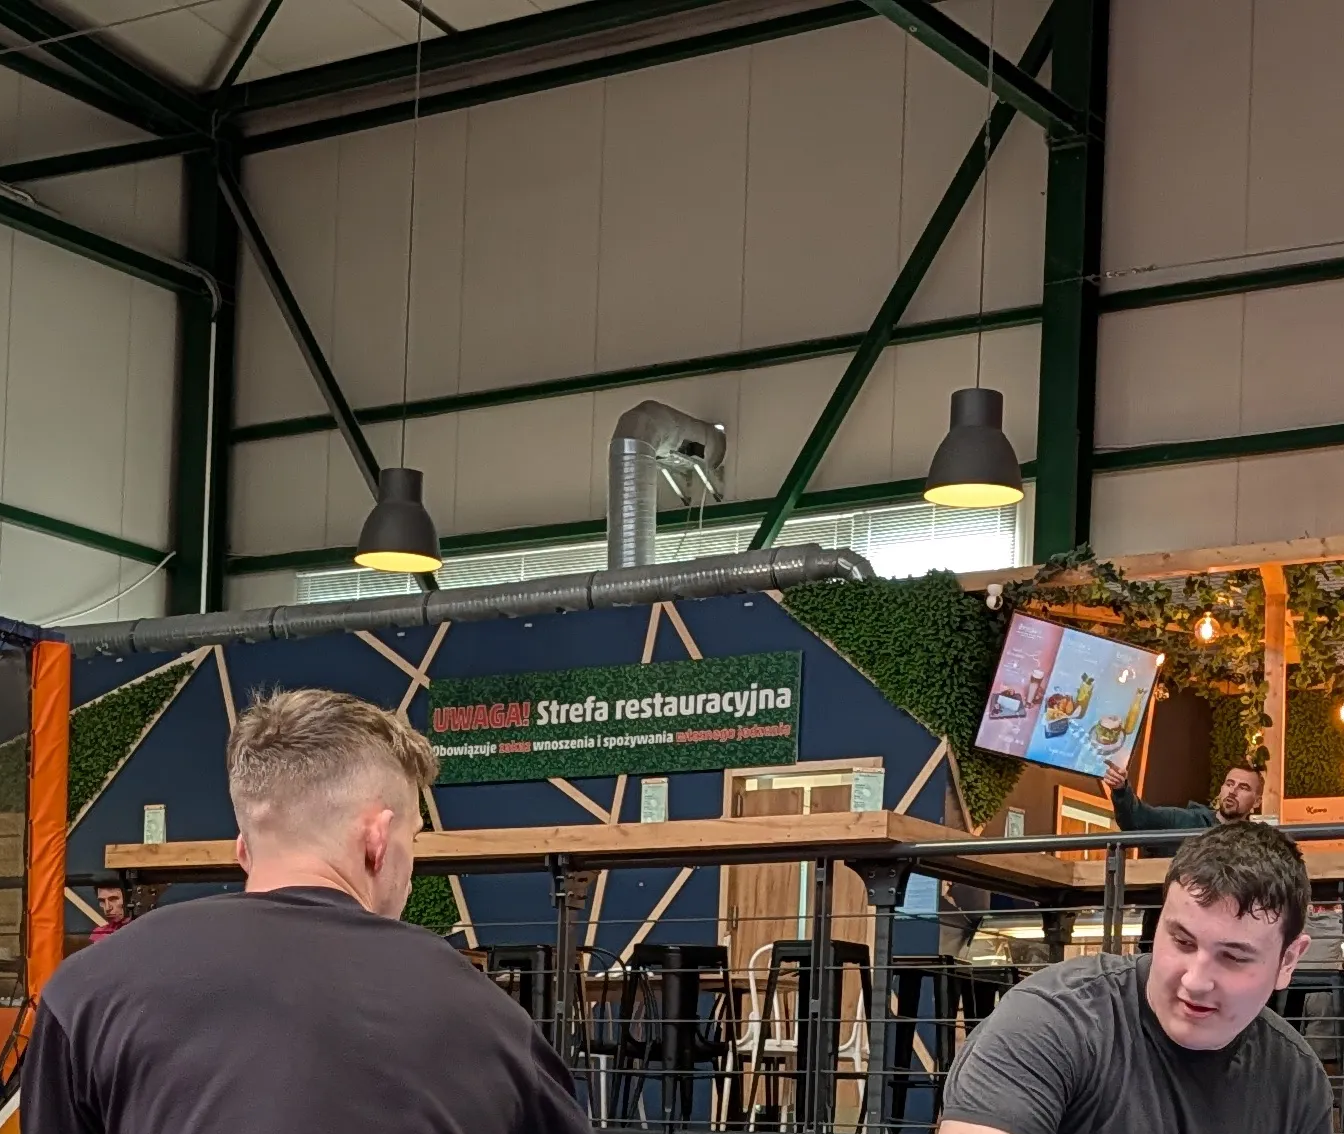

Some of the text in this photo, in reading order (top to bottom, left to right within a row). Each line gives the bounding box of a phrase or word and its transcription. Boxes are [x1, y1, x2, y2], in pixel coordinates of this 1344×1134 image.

[433, 683, 792, 733] UWAGA! Strefa restauracyjna
[432, 741, 497, 759] Obowiązuje
[533, 735, 596, 752] wnoszenia
[603, 730, 674, 750] spożywania
